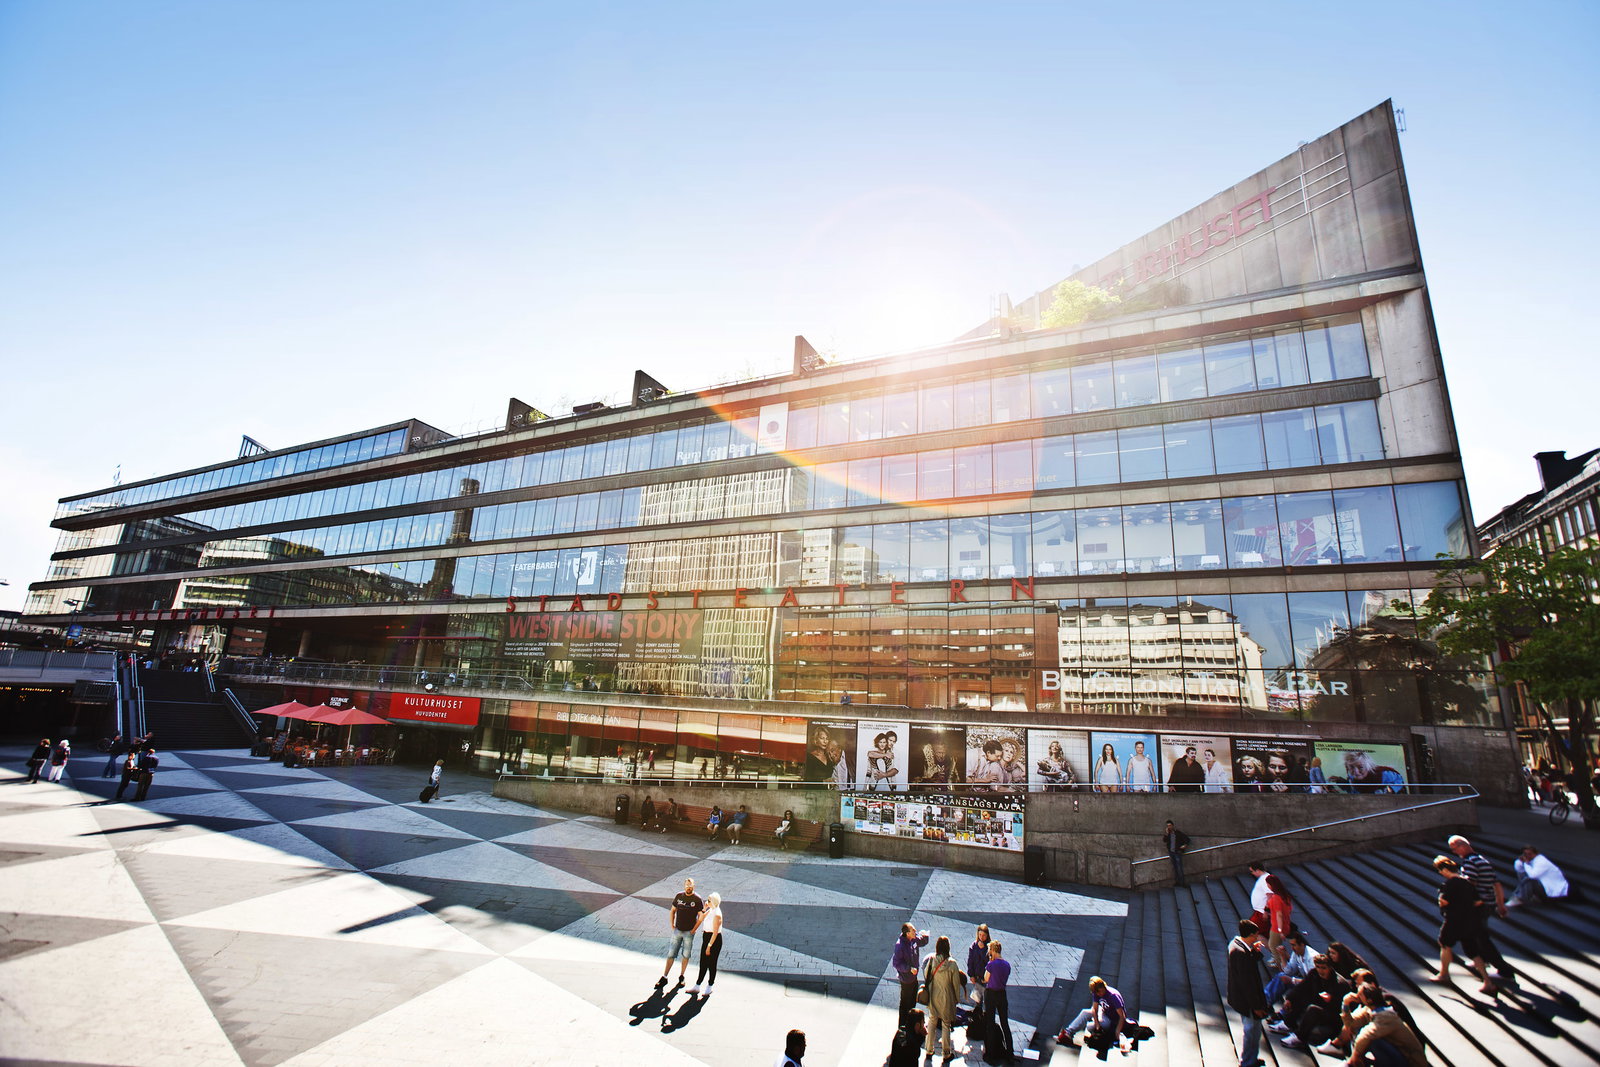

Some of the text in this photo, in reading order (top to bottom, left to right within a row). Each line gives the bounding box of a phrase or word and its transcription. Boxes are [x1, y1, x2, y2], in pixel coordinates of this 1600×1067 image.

[1095, 187, 1276, 294] TURHUSET
[511, 561, 560, 571] TEATERBAREN
[506, 575, 1036, 613] STADSTEATERN
[116, 605, 275, 622] KULTURHUSET
[509, 613, 701, 639] WEST SIDE STORY
[1286, 672, 1349, 696] BAR
[405, 697, 463, 709] KULTURHUSET
[556, 711, 589, 722] BIBLOTEK
